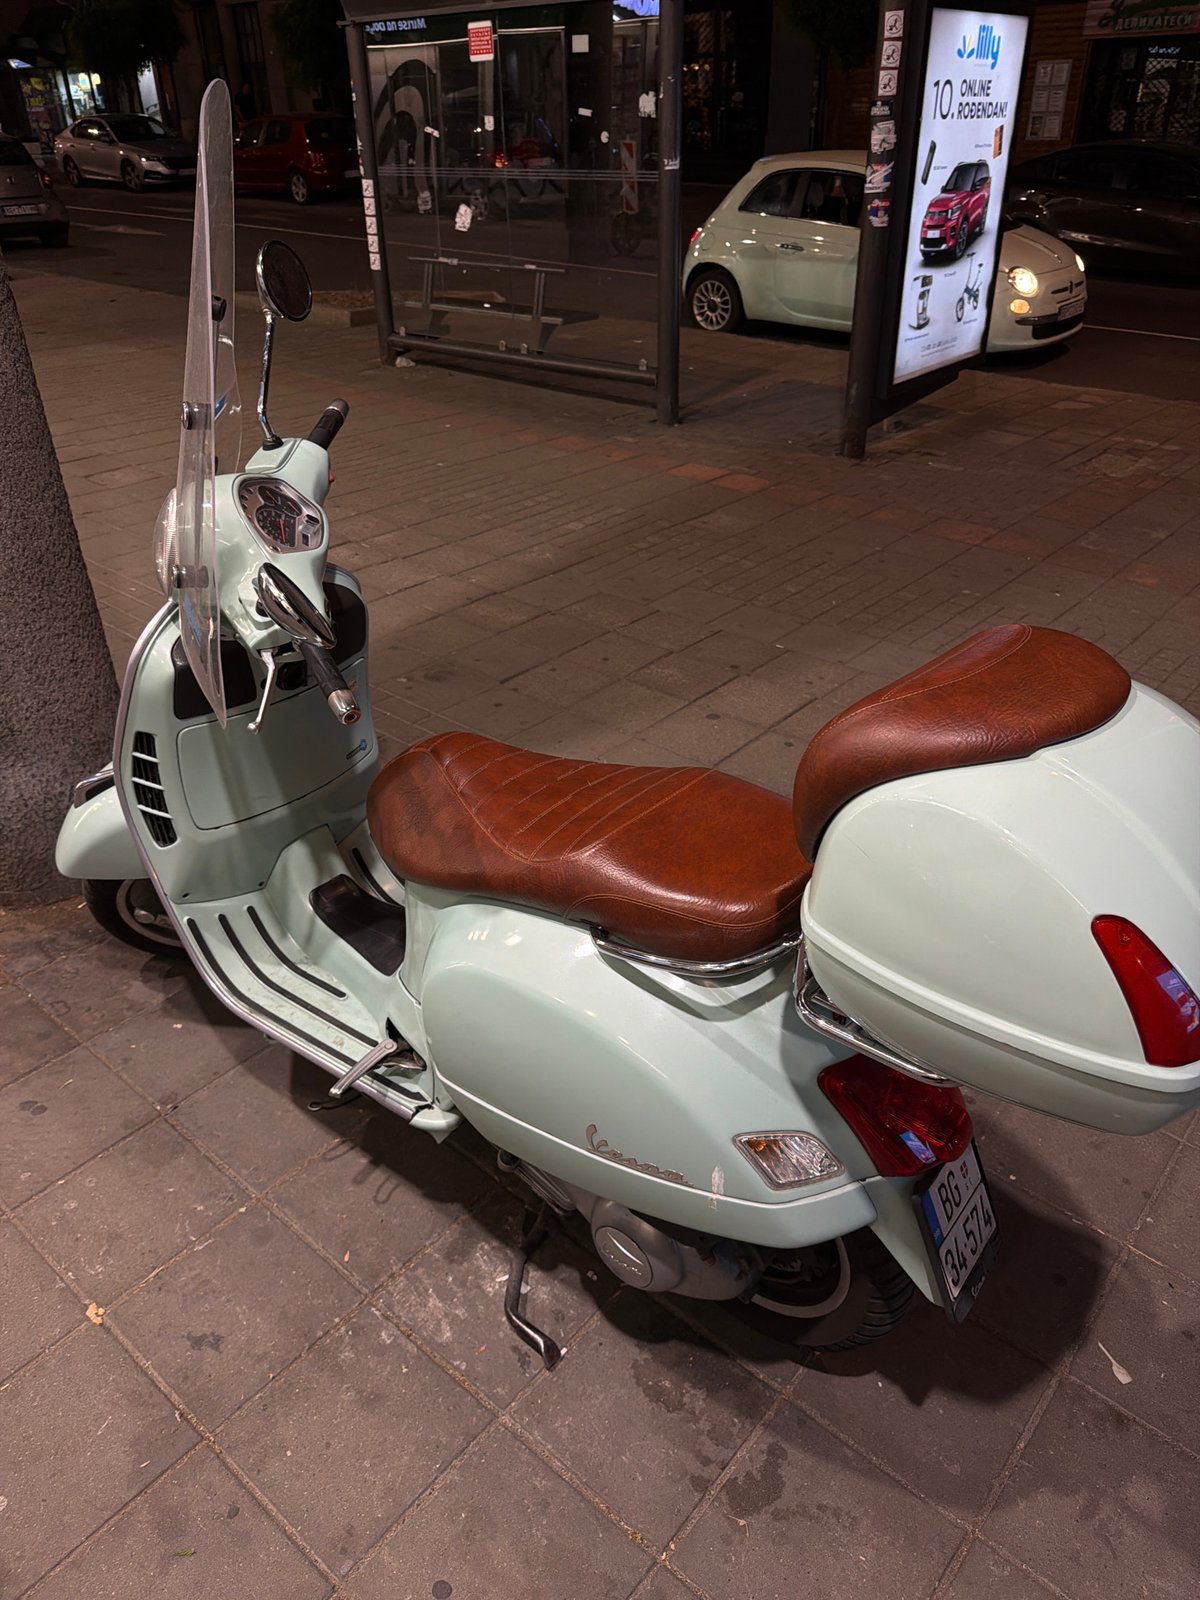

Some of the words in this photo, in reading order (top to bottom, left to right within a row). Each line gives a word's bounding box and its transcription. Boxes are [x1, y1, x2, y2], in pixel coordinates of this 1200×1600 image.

[975, 24, 1001, 70] lilly
[933, 79, 955, 120] 10.
[960, 79, 992, 97] ONLINE
[957, 101, 1008, 119] ROĐENDAN!
[937, 1170, 961, 1223] BG
